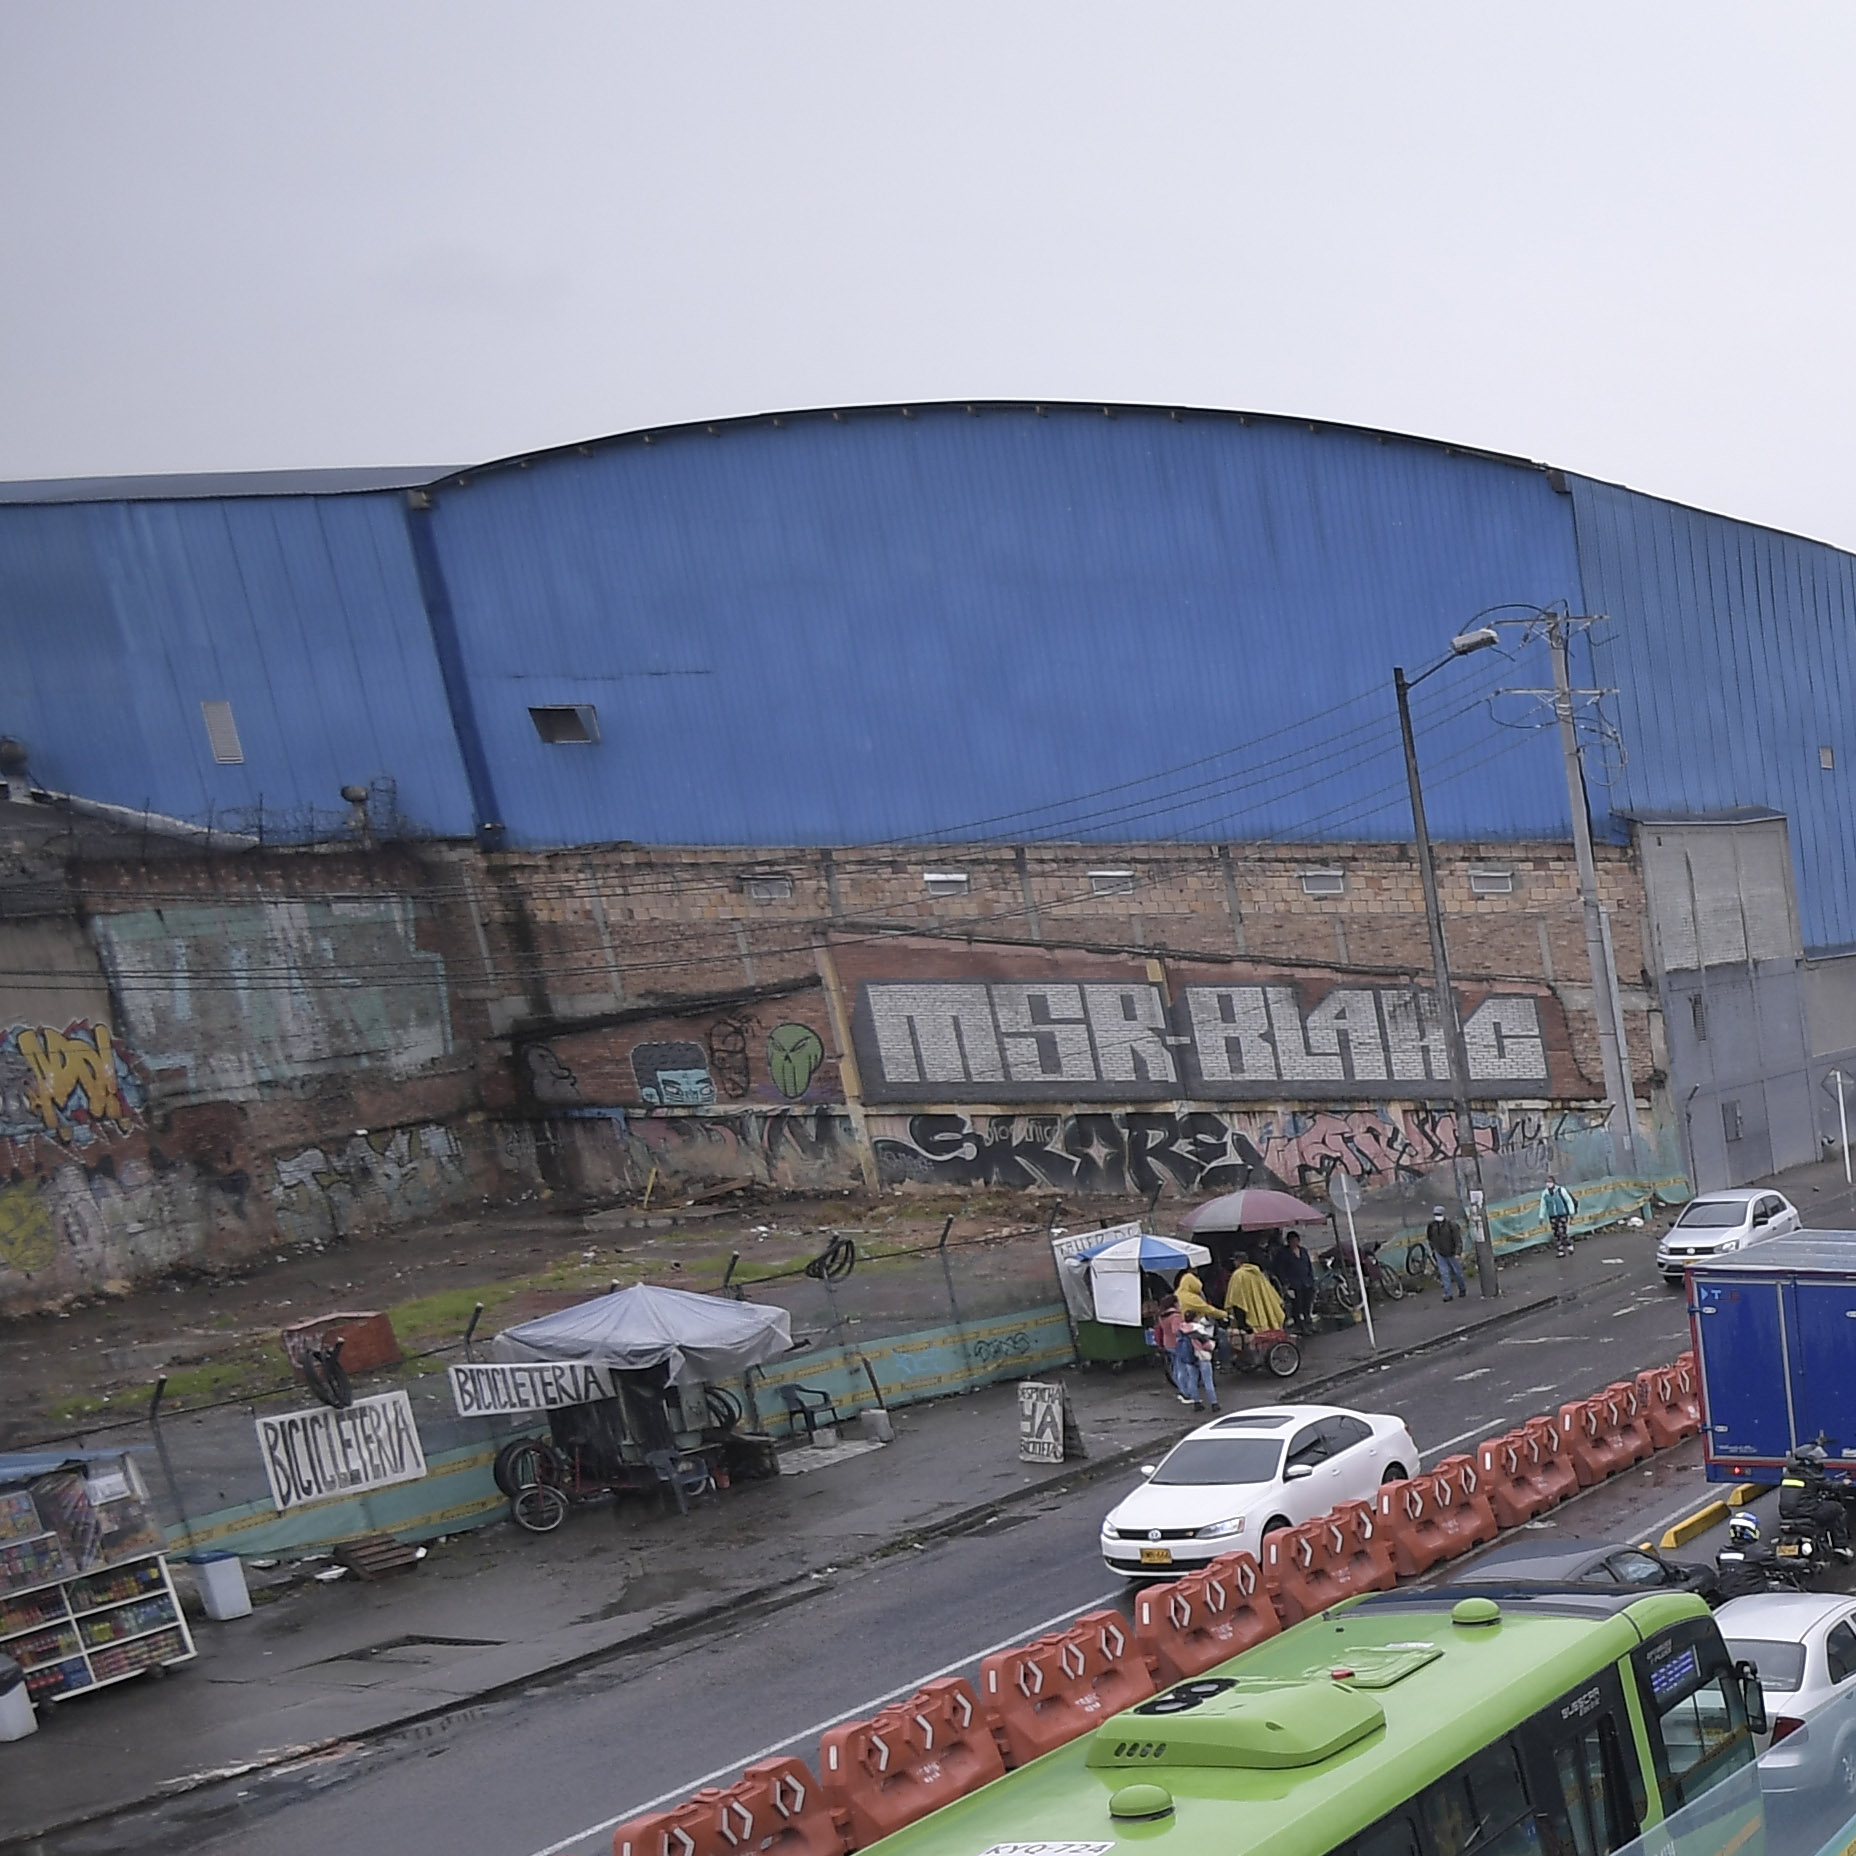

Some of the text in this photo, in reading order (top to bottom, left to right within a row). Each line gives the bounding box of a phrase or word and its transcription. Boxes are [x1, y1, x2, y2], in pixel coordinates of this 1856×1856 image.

[455, 1365, 605, 1412] BICICLETERIA
[264, 1399, 422, 1507] BICICLETERIA
[985, 1843, 1110, 1856] KYQ-724
